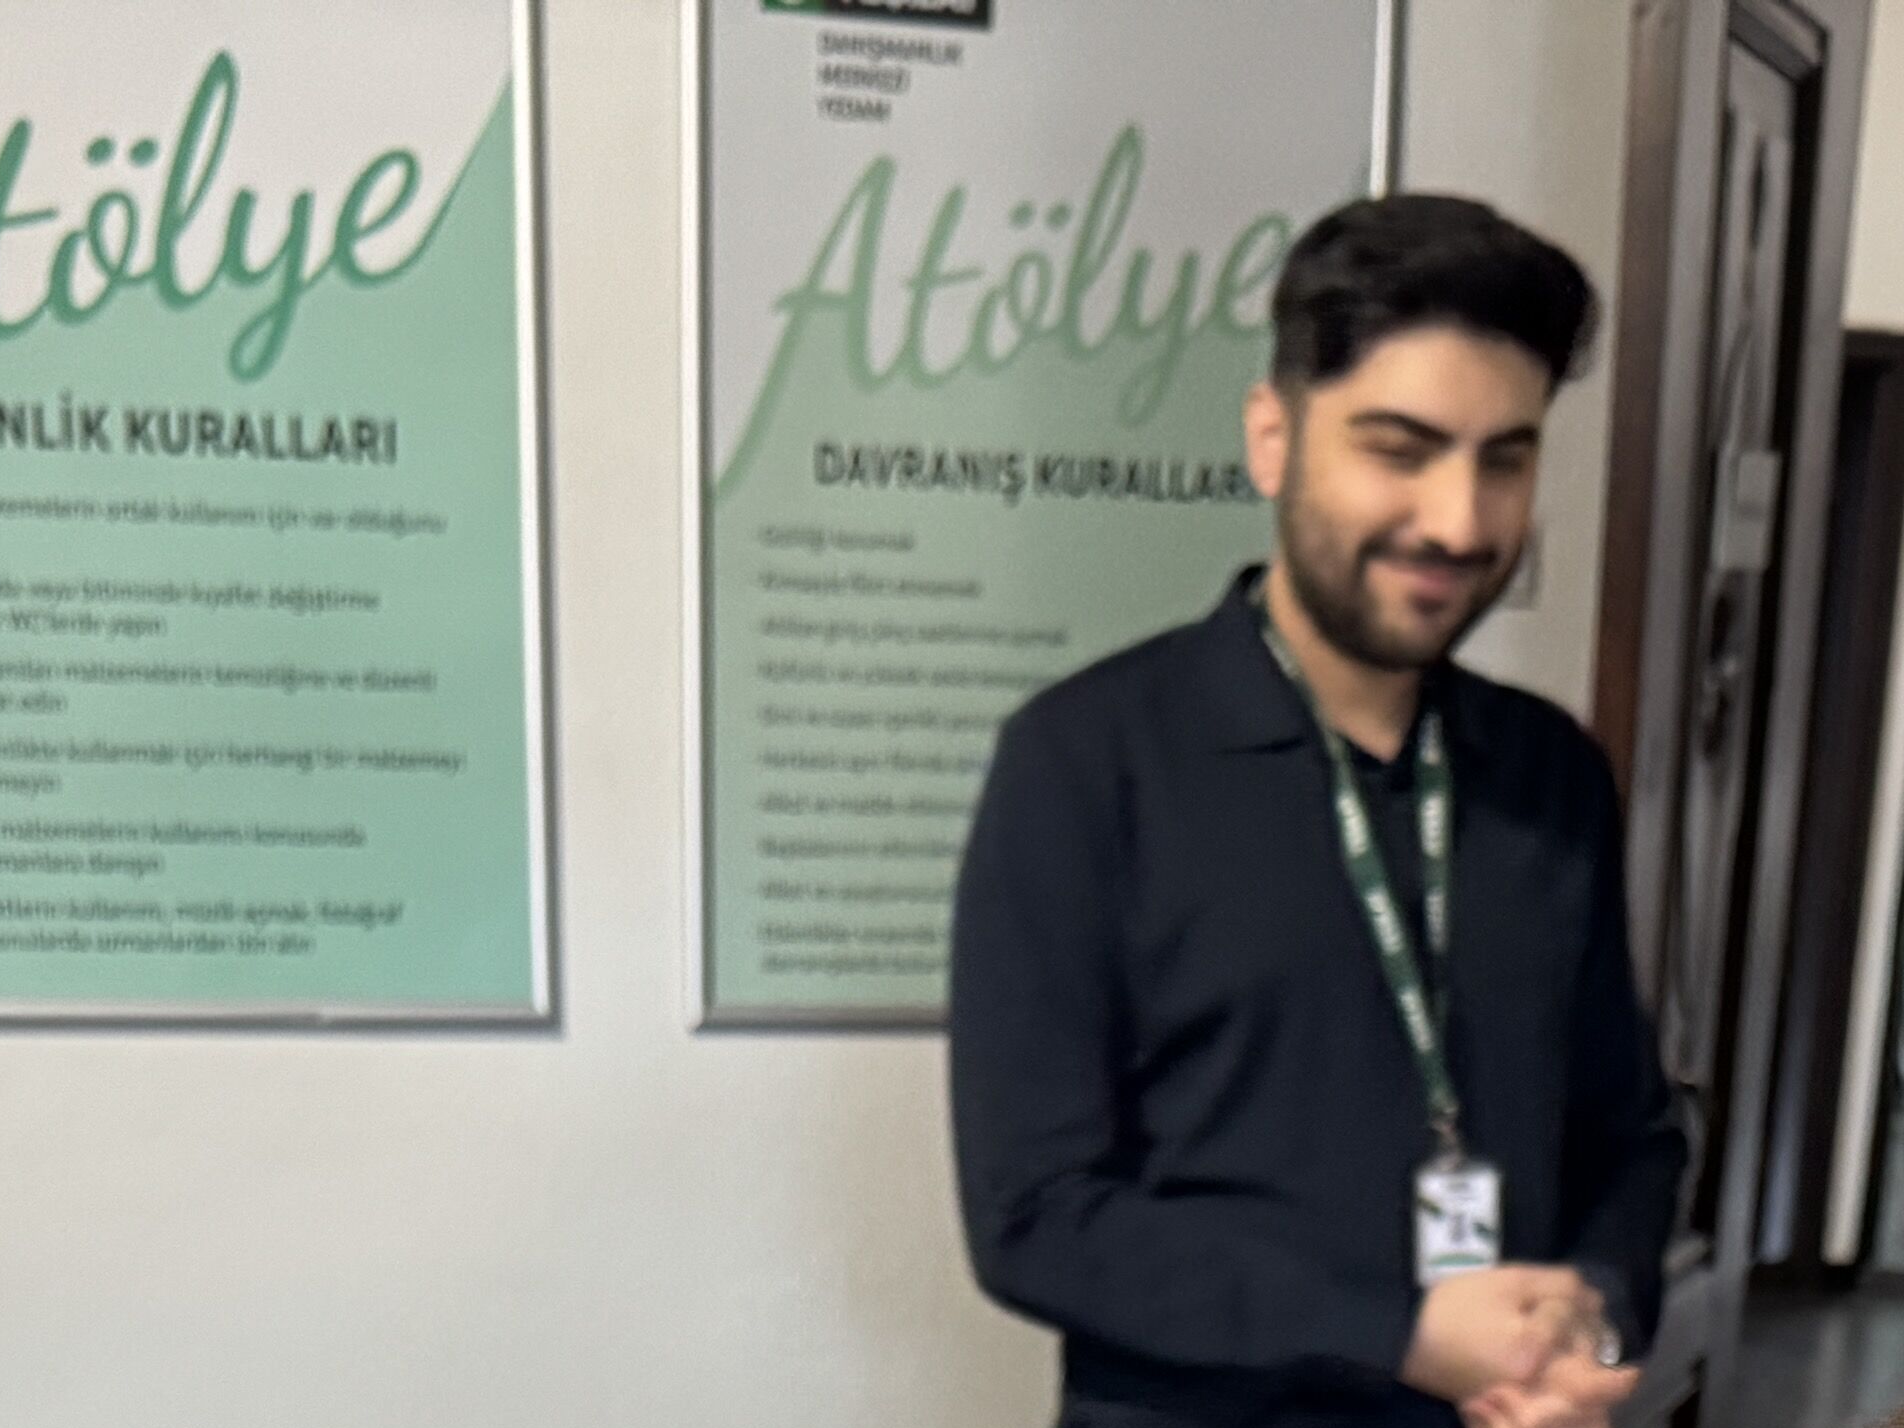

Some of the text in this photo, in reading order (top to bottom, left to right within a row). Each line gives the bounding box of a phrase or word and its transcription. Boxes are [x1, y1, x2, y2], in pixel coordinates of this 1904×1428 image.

[718, 122, 1291, 498] Atölye
[124, 406, 396, 466] KURALLARI
[813, 440, 1027, 507] DAVRANIŞ
